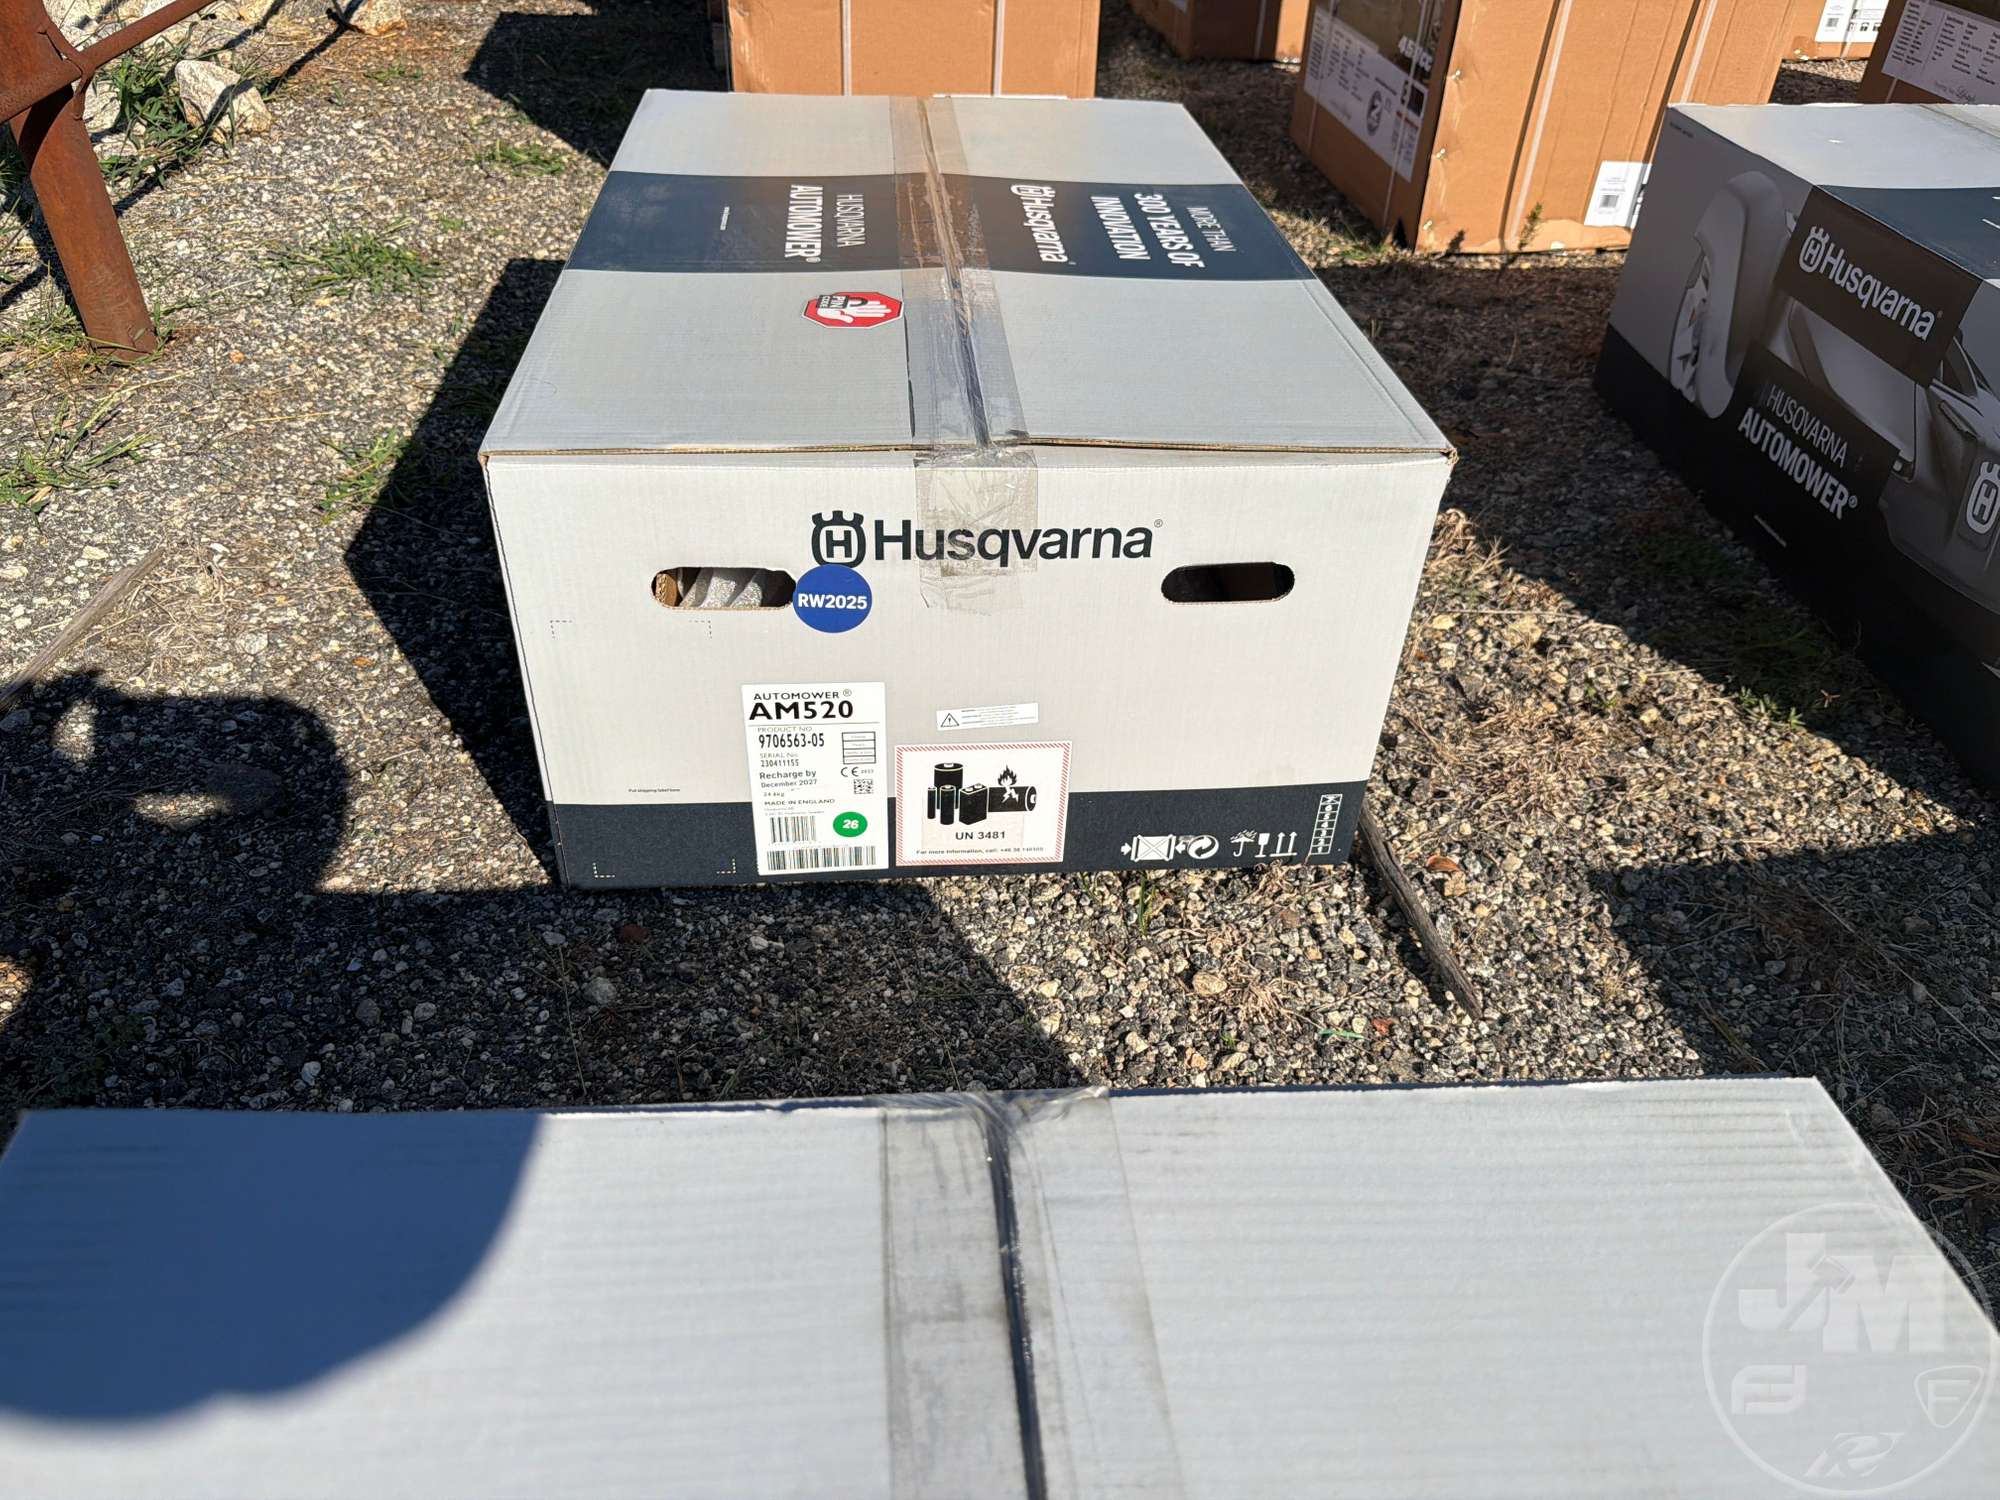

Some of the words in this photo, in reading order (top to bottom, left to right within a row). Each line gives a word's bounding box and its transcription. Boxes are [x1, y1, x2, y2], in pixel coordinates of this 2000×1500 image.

[1134, 193, 1171, 214] 300
[834, 194, 866, 248] HUSQVARNA
[1091, 196, 1151, 260] INNOVATION
[1187, 206, 1219, 230] MORE
[1020, 195, 1068, 263] Husqvarna
[1147, 214, 1194, 251] YEARS
[1202, 229, 1237, 252] THAN
[1168, 251, 1205, 268] OF
[1819, 241, 1937, 342] Husqvarna
[1765, 384, 1849, 469] HUSQVARNA
[798, 593, 868, 611] RW2025
[749, 700, 854, 720] AM520
[758, 733, 825, 749] 9706563-05
[760, 759, 799, 768] 230411155
[760, 770, 803, 780] Recharge
[805, 769, 817, 778] by
[761, 780, 798, 788] December
[842, 819, 859, 830] 26
[955, 831, 974, 840] UN
[977, 831, 1006, 840] 3481
